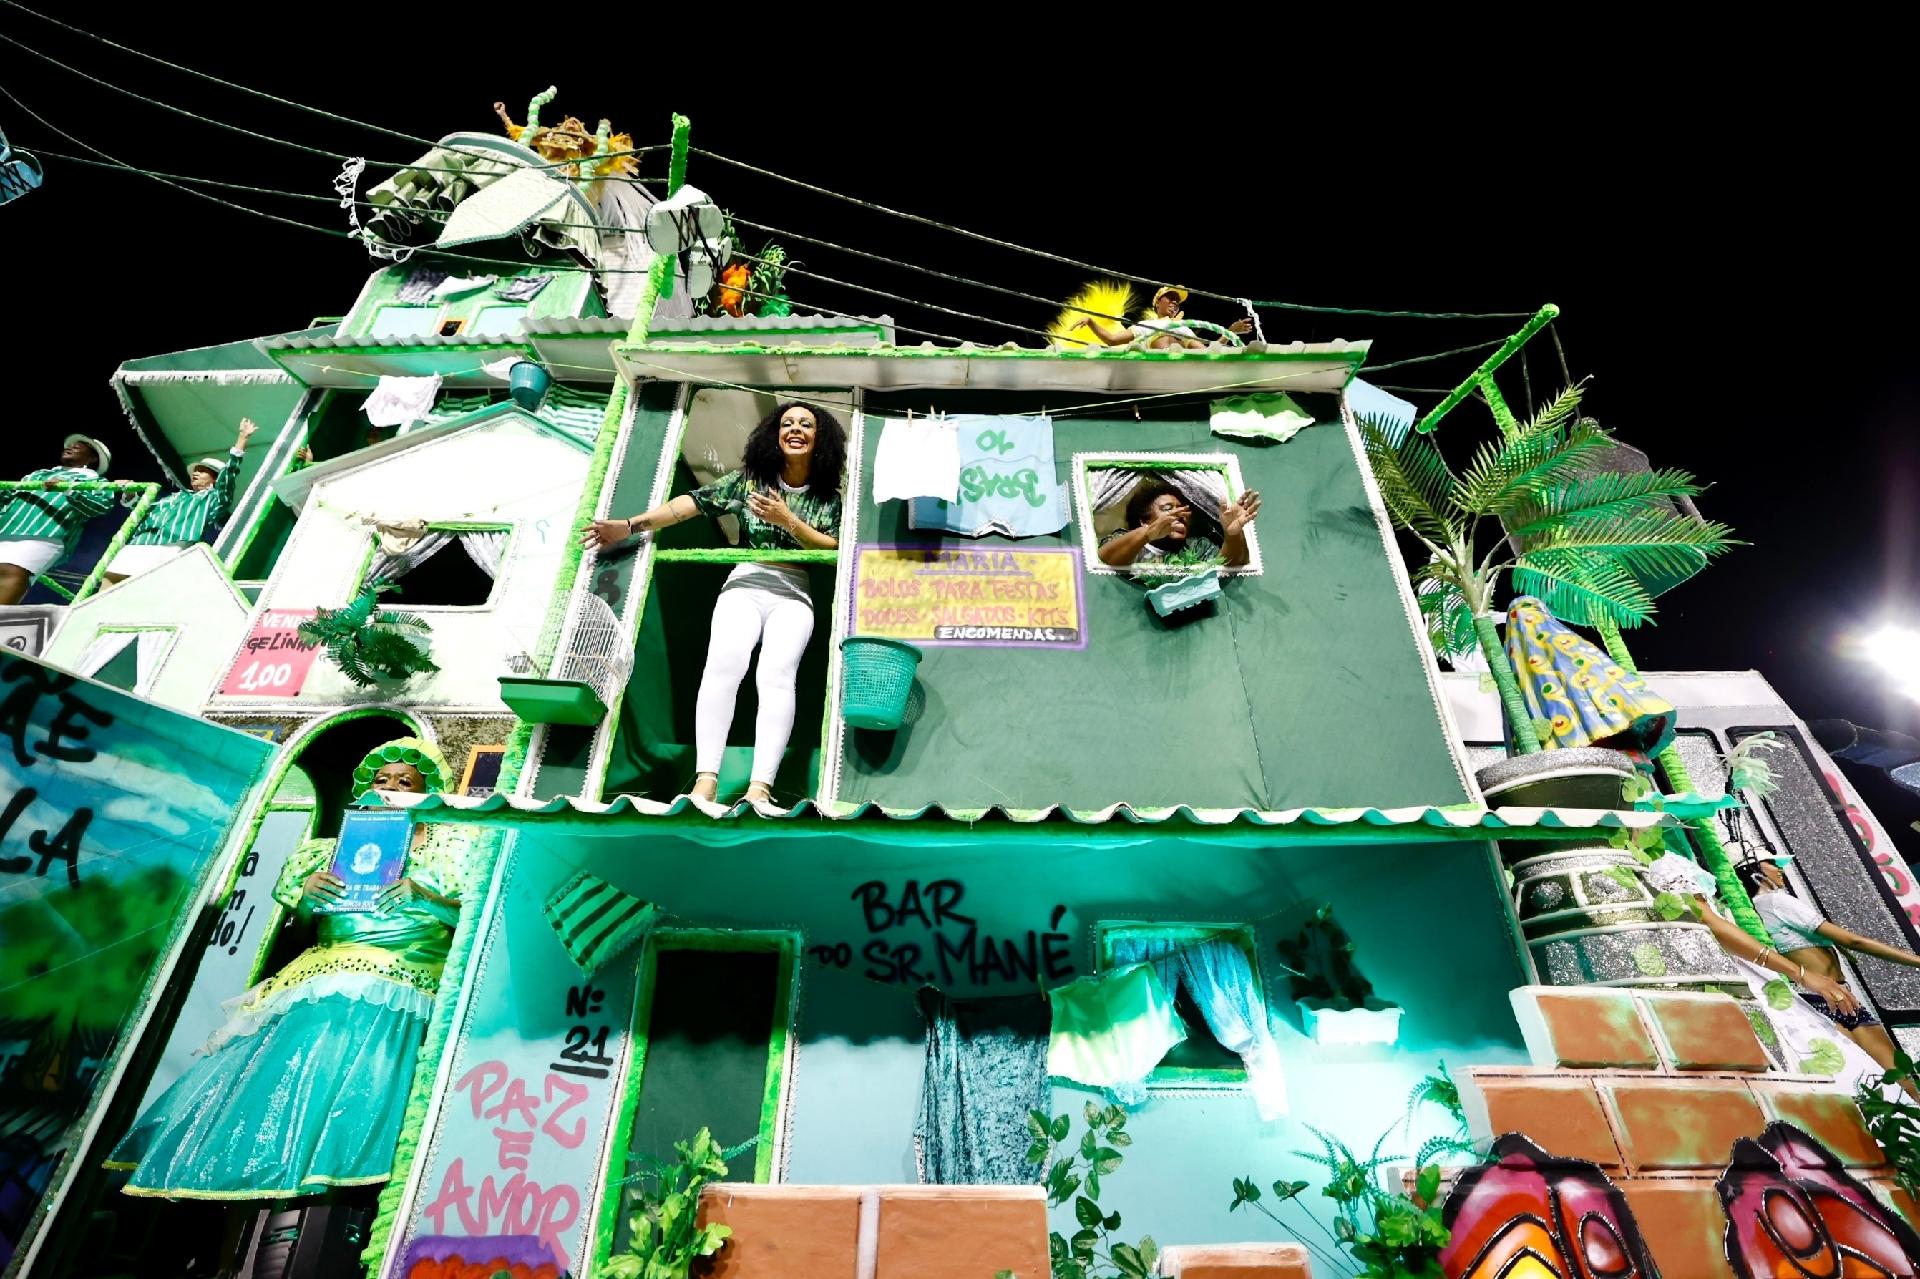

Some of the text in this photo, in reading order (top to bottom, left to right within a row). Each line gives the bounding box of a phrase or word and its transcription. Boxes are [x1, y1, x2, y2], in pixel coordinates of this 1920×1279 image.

[860, 577, 1060, 600] BOLOS PARA FESTAS
[851, 878, 977, 933] BAR
[808, 942, 852, 968] DO
[933, 904, 1075, 985] MANÉ
[560, 1025, 614, 1066] 21
[454, 1060, 589, 1149] PAZ
[493, 1127, 534, 1171] E
[424, 1157, 580, 1275] AMOR
